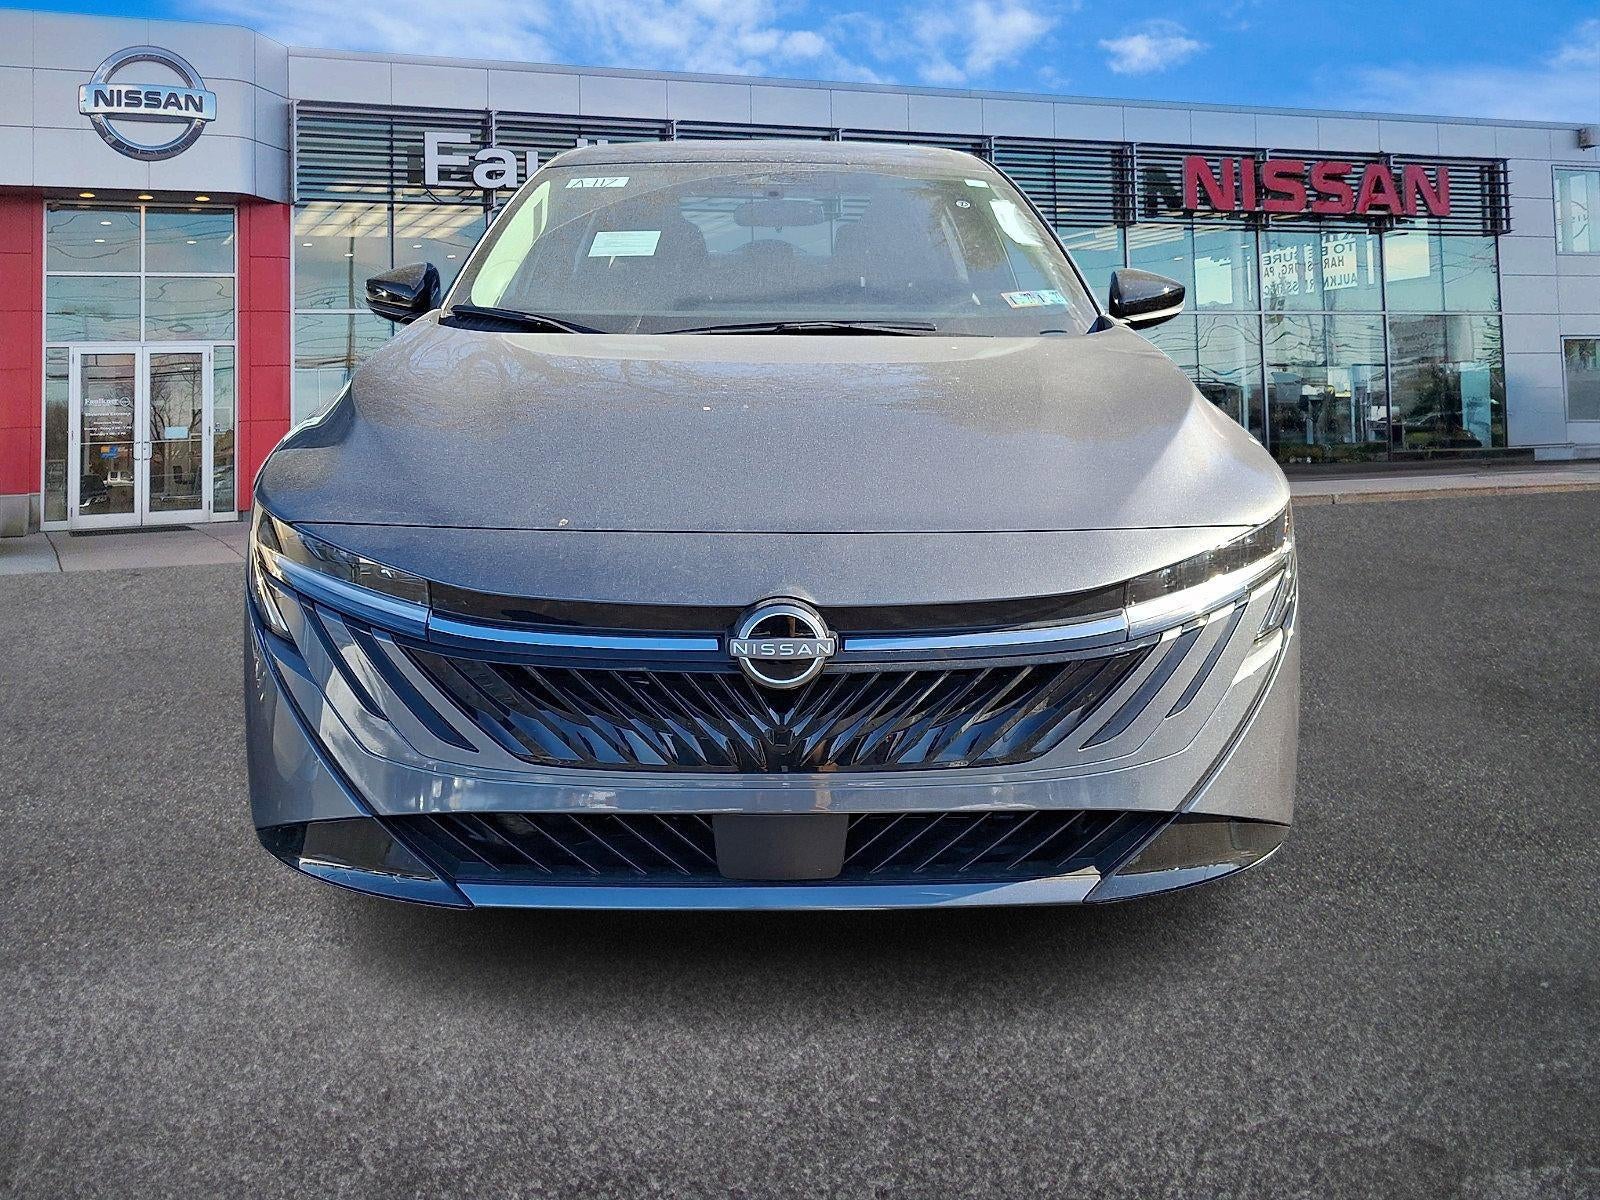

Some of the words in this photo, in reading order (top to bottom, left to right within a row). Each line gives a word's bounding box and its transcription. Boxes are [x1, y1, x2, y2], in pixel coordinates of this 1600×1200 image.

[93, 89, 204, 113] NISSAN
[1182, 155, 1450, 217] NISSAN
[733, 642, 831, 656] NISSAN
